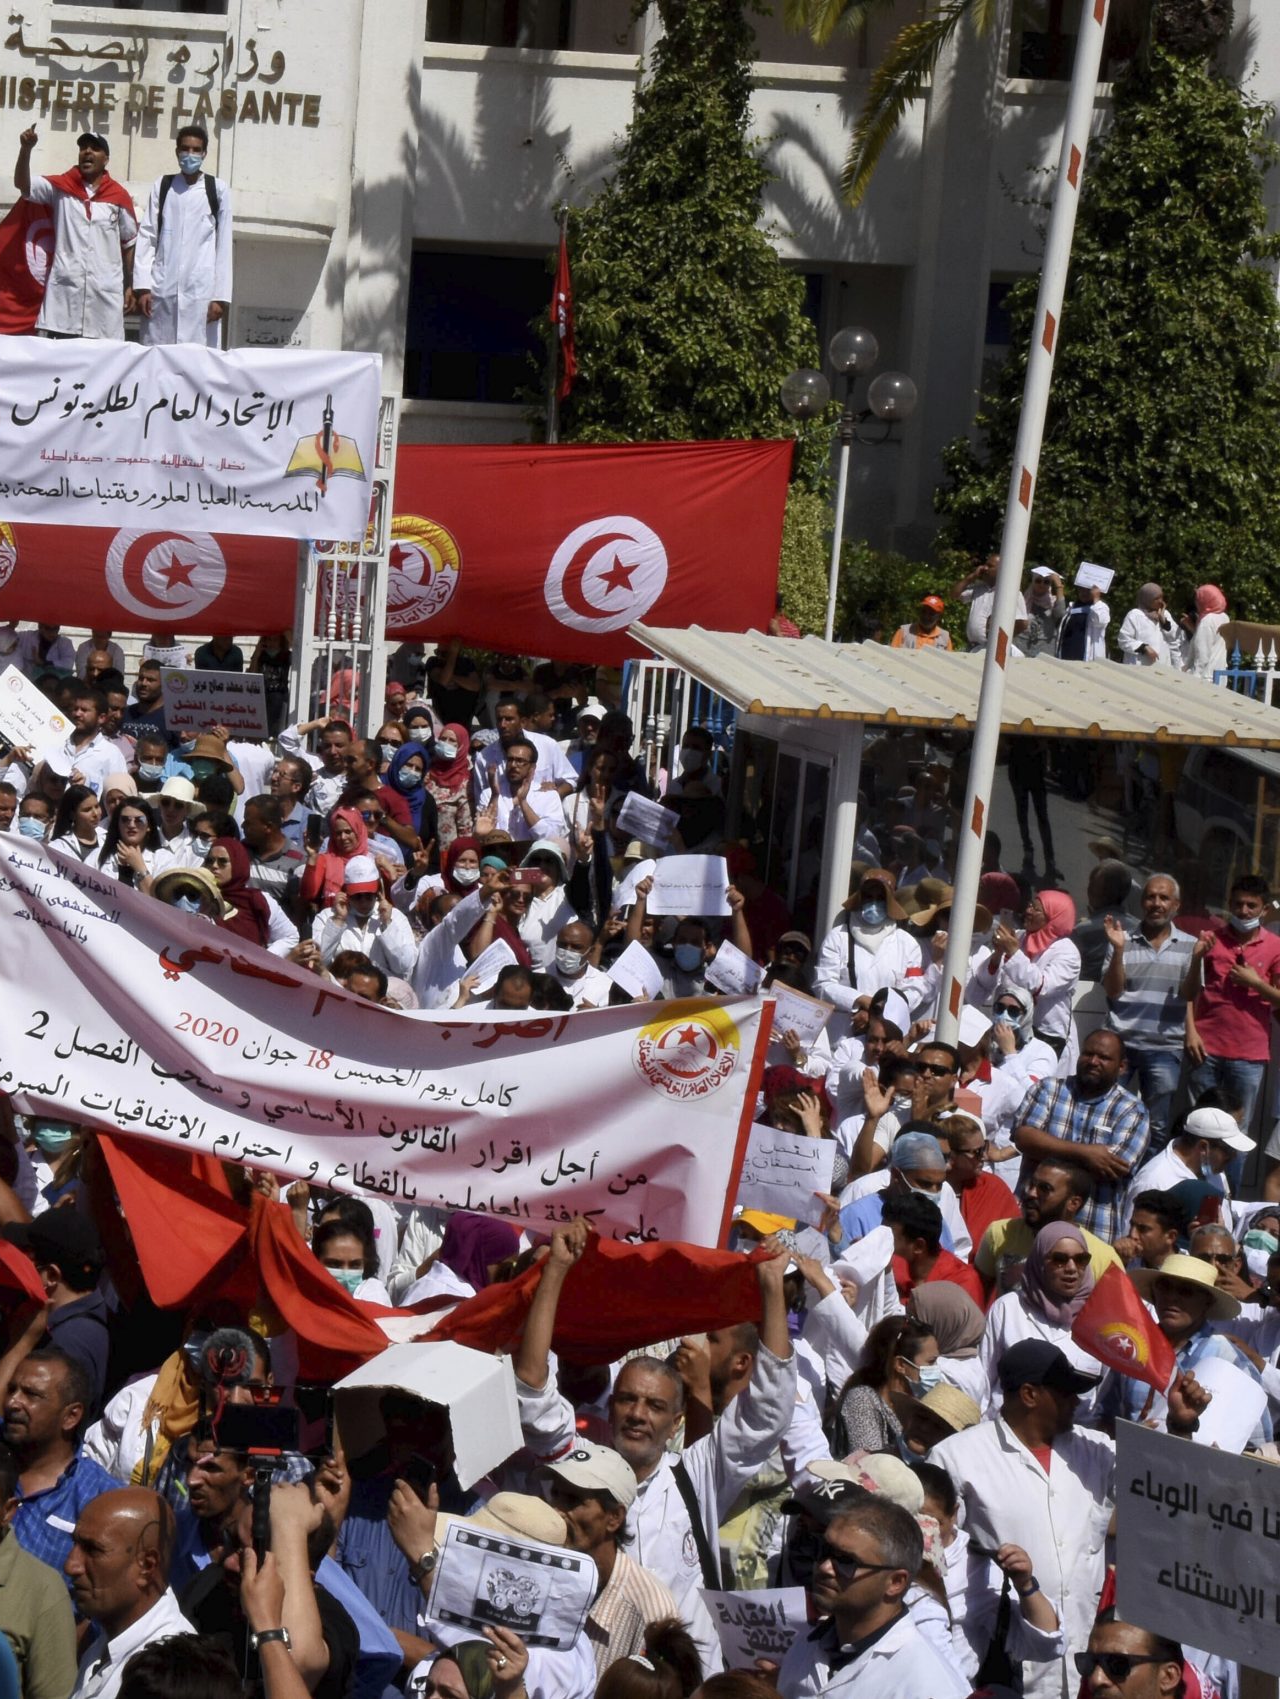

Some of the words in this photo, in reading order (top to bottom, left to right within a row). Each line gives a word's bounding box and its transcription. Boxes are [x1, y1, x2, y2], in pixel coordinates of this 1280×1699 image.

[4, 13, 149, 62] الصحة
[167, 34, 286, 84] وزارة
[129, 83, 165, 115] DE
[177, 87, 214, 118] LA
[220, 89, 322, 128] SANTE
[11, 377, 86, 427] تونس
[82, 382, 139, 428] لطلبة
[143, 392, 212, 439] العام
[11, 476, 70, 498] الصحة
[197, 482, 237, 511] العليا
[239, 491, 319, 513] المدرسة
[24, 1009, 51, 1041] 2
[173, 1010, 240, 1047] 2020
[53, 1024, 141, 1067] الفصل
[241, 1033, 299, 1067] جوان
[303, 1047, 335, 1071] 18
[150, 1058, 225, 1095] سحب
[333, 1068, 421, 1090] الخميس
[419, 1081, 458, 1102] يوم
[234, 1089, 252, 1110] و
[460, 1082, 520, 1109] كامل
[79, 1092, 207, 1141] الاتفاقيات
[261, 1098, 366, 1131] الأساسي
[212, 1130, 295, 1162] احترام
[377, 1114, 458, 1154] القانون
[303, 1160, 320, 1181] و
[470, 1140, 532, 1170] اقرار
[539, 1149, 602, 1187] أجل
[327, 1160, 418, 1202] بالقطاع
[607, 1169, 648, 1195] من
[1129, 1469, 1198, 1518] الوباء
[1207, 1501, 1254, 1533] في
[715, 1598, 787, 1627] النقابة
